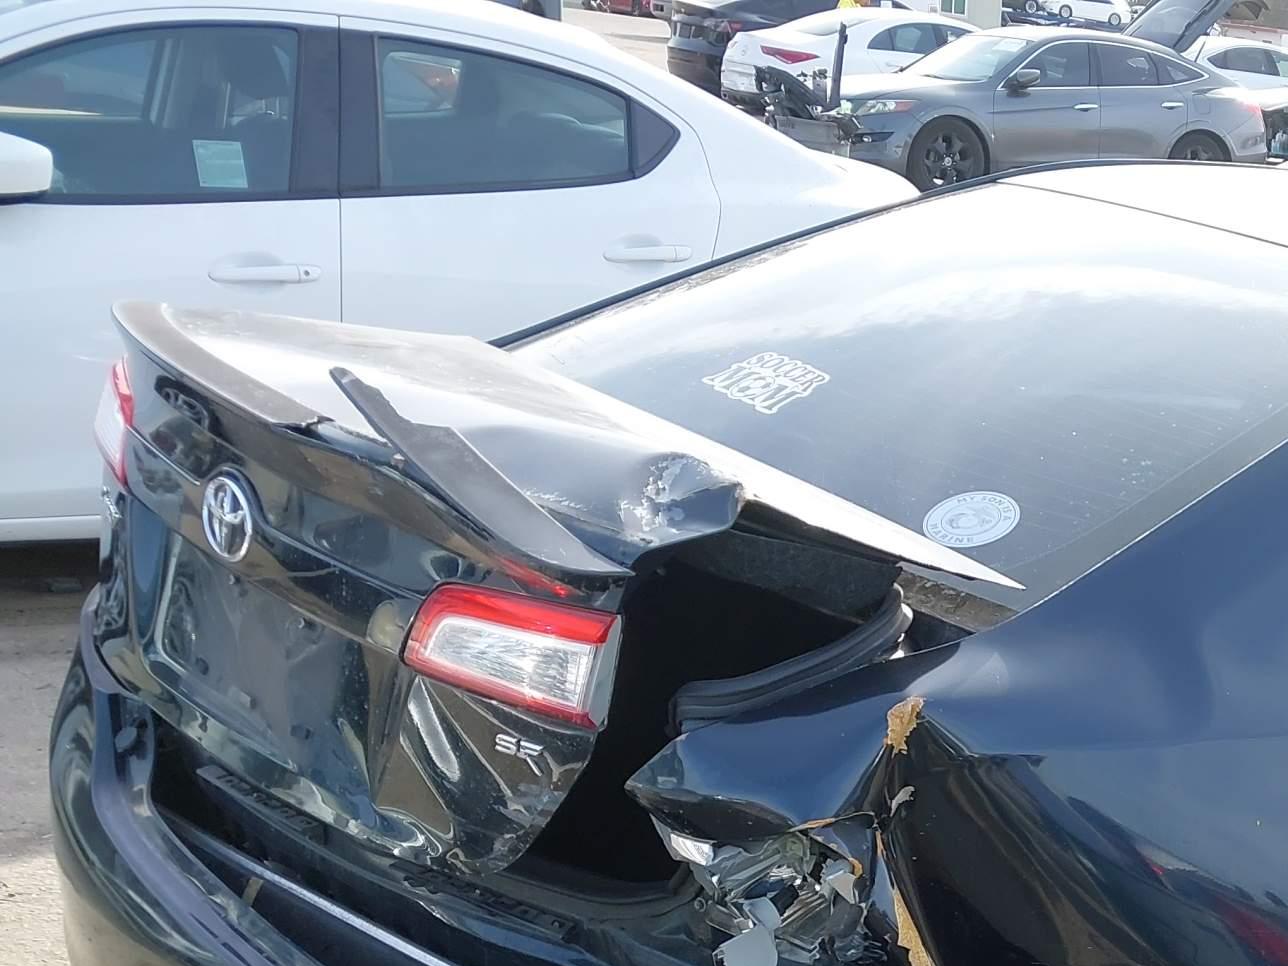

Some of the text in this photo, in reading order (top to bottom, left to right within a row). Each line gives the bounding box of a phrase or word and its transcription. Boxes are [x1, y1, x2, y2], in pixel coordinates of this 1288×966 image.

[745, 352, 829, 392] SOCCER
[703, 363, 818, 413] MOM
[957, 496, 975, 504] MY
[981, 496, 1003, 506] SON
[928, 523, 975, 543] MARINE
